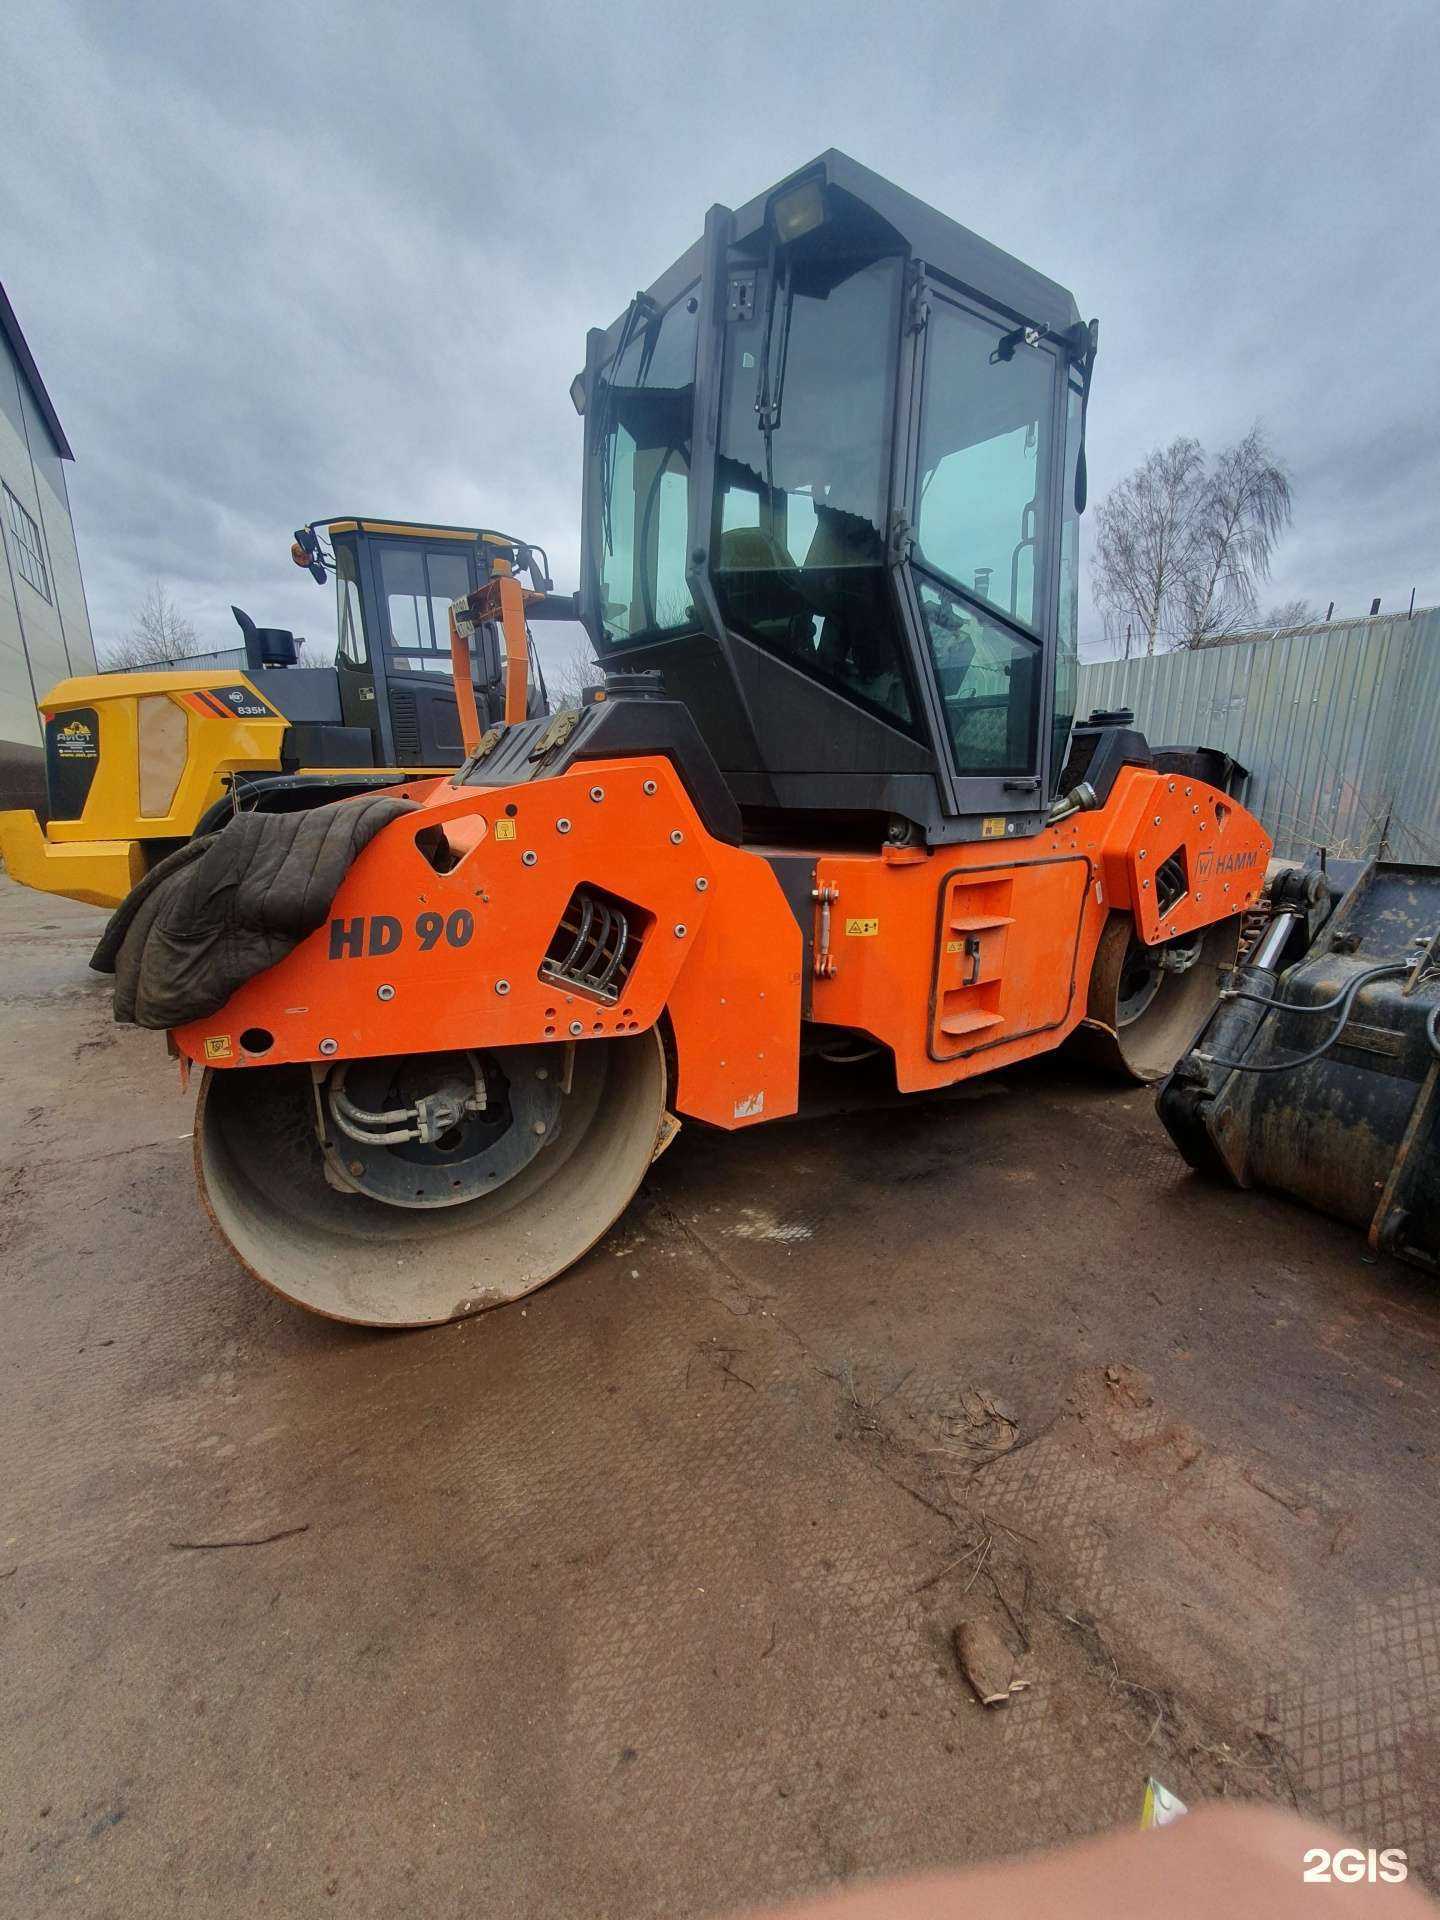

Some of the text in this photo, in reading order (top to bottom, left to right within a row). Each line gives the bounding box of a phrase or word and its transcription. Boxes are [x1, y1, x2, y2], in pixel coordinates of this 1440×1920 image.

[238, 706, 266, 715] 835H
[1216, 848, 1259, 875] HAMM
[328, 908, 475, 960] HD 90
